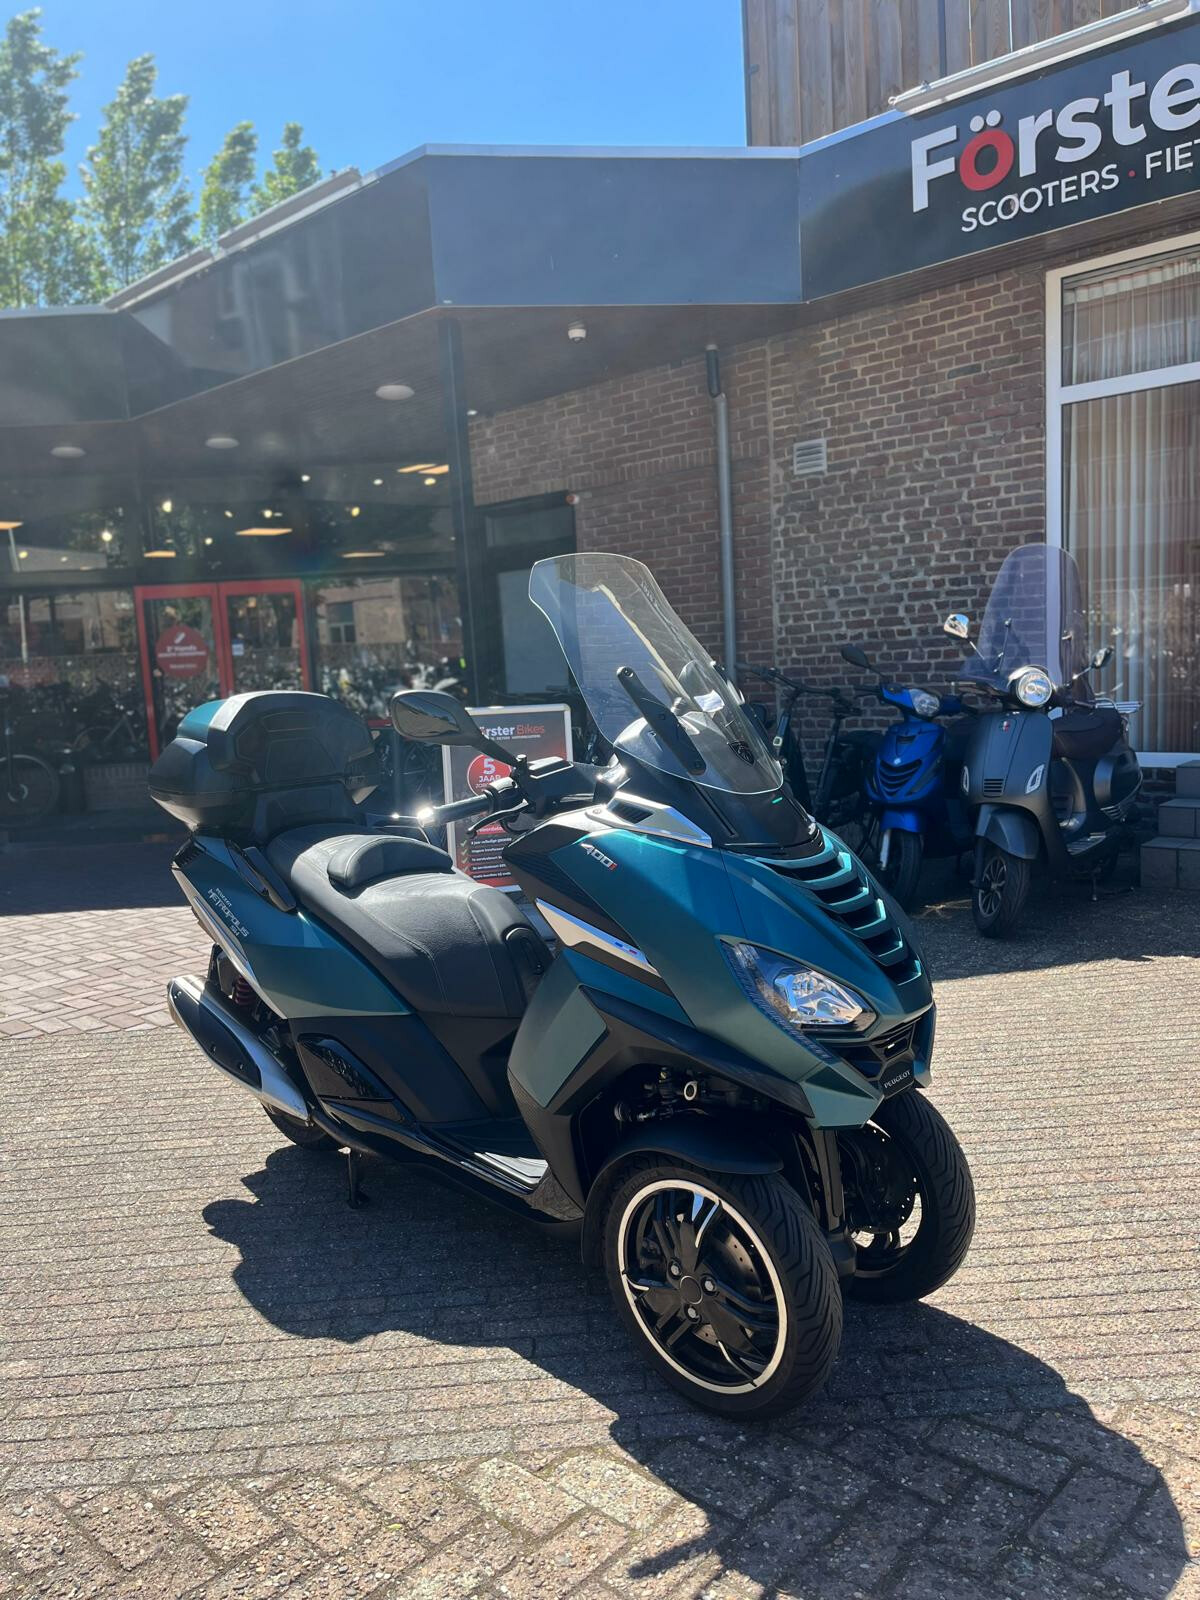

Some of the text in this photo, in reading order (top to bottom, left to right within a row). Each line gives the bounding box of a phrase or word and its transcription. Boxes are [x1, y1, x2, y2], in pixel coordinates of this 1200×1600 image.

[911, 63, 1200, 213] Förste
[961, 138, 1200, 232] SCOOTERS FIE
[479, 725, 516, 737] örster
[516, 723, 545, 735] Bikes
[483, 757, 496, 775] 5
[207, 888, 250, 937] METROPOLIS
[883, 1069, 912, 1089] PEUGEOT
